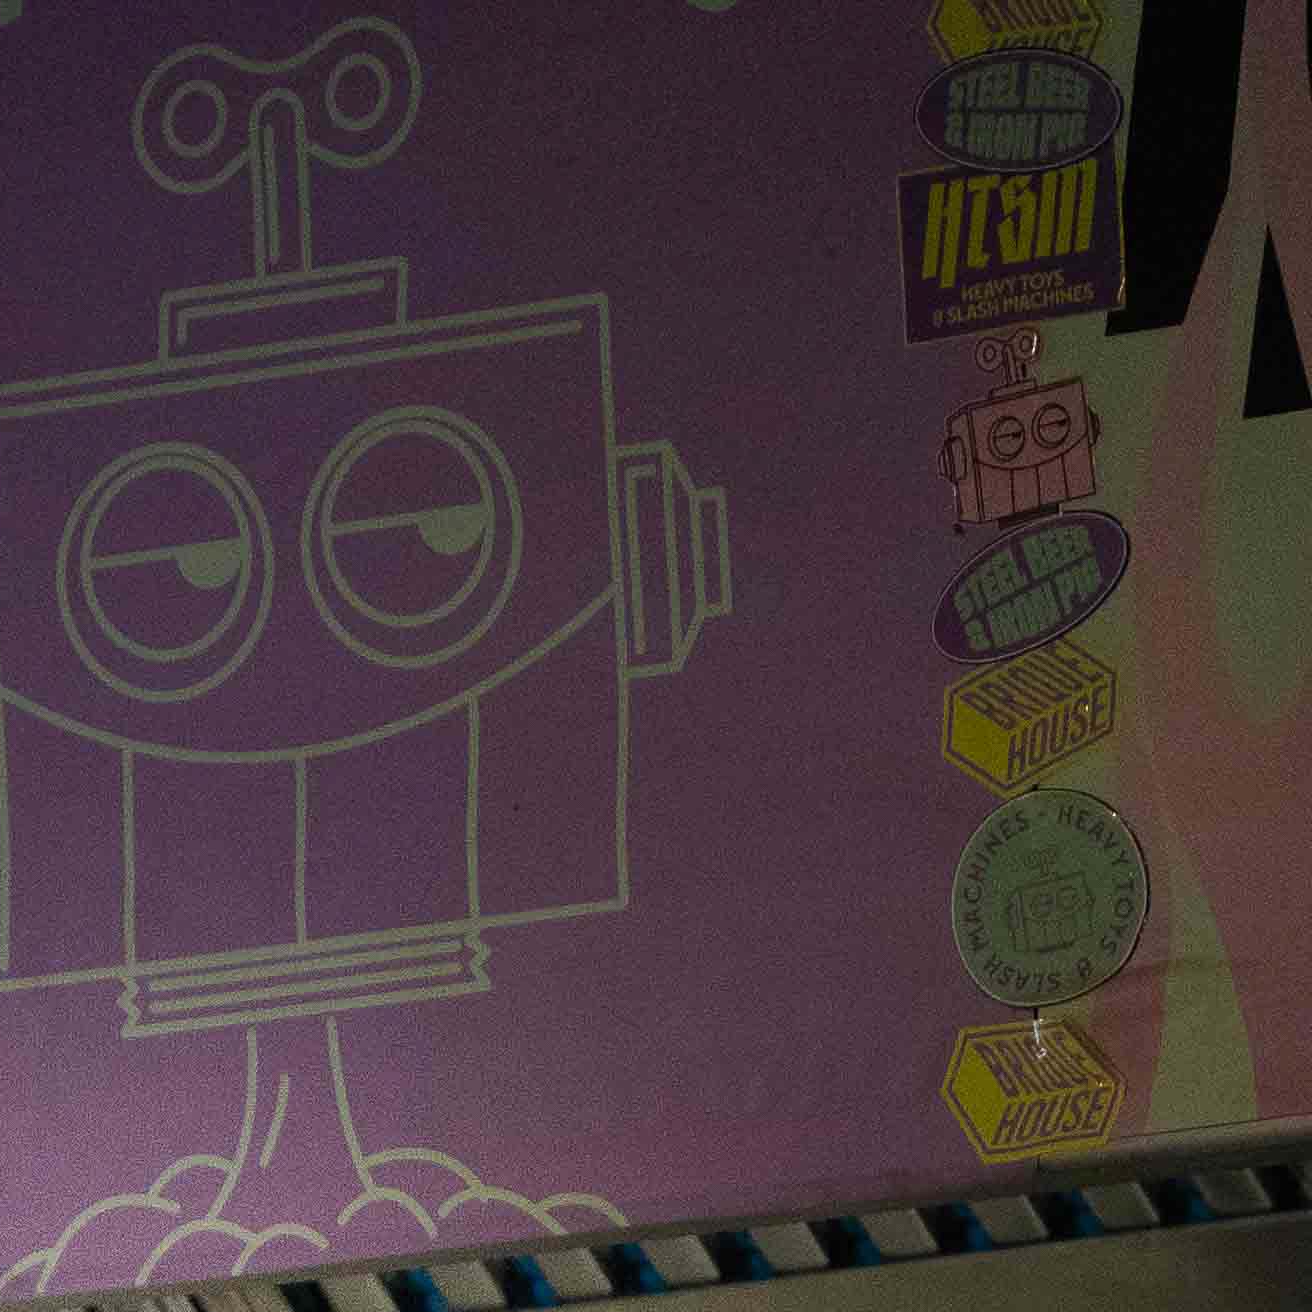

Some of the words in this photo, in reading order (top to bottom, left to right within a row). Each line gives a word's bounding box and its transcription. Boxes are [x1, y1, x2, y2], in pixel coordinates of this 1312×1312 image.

[921, 157, 1098, 290] HTSM
[946, 297, 1001, 324] SLASH
[1001, 283, 1095, 316] MACHINES
[960, 275, 1018, 302] HEAVY
[1020, 268, 1065, 291] TOYS
[1008, 685, 1108, 780] HOUSE
[1057, 804, 1131, 867] HEAVY
[962, 811, 1029, 952] MACHINES
[1100, 881, 1135, 957] TOYS
[982, 952, 1061, 993] SLASH
[991, 1086, 1109, 1146] HOUSE
